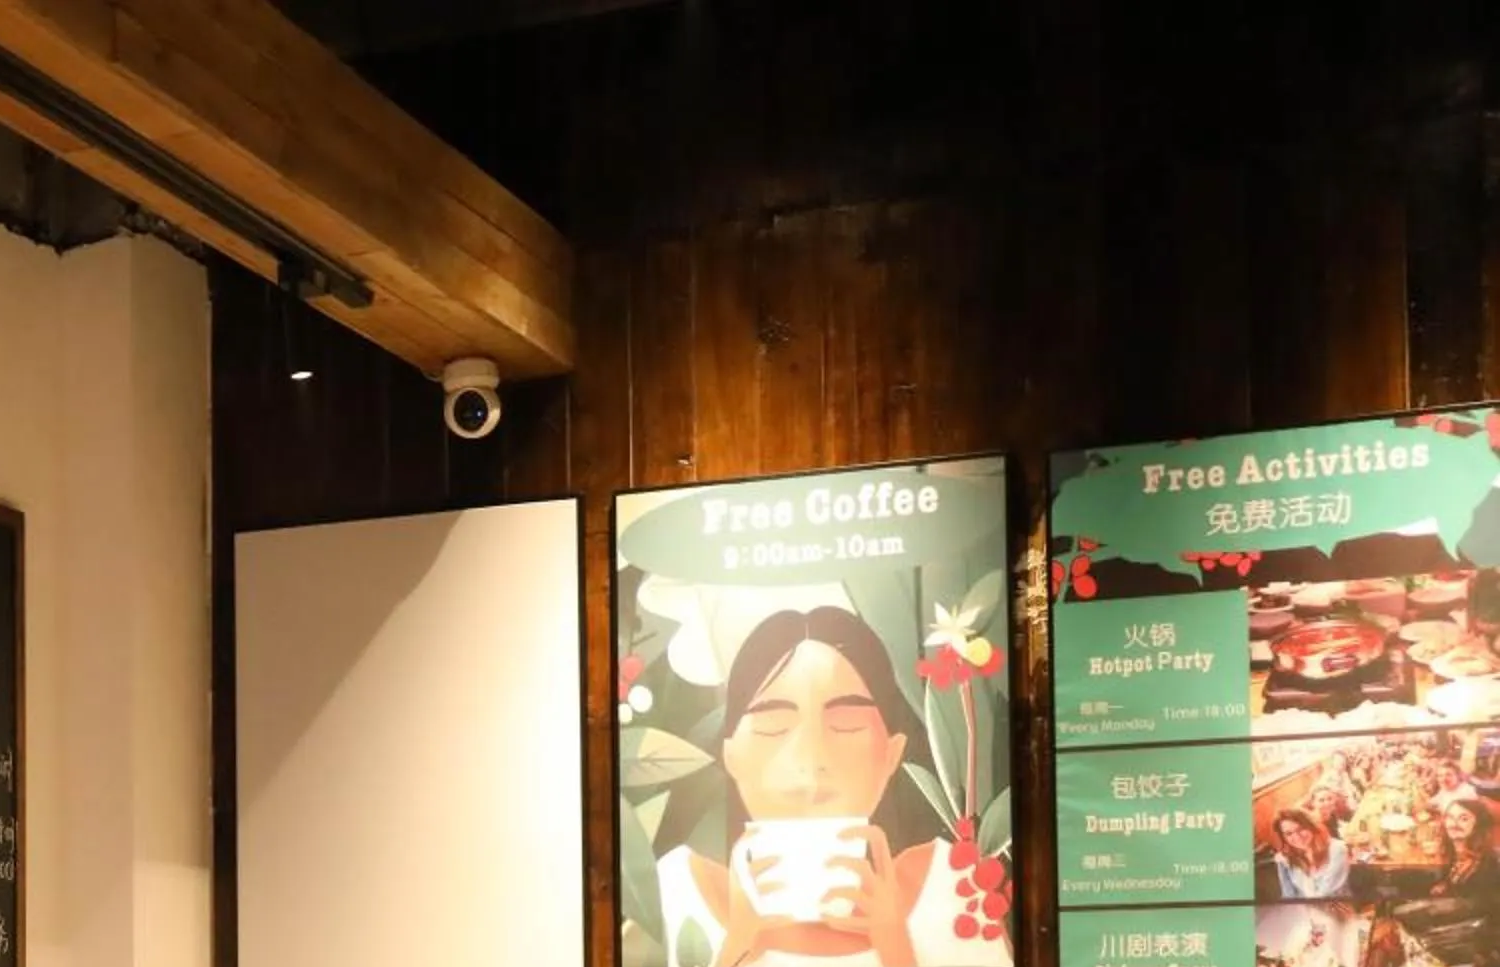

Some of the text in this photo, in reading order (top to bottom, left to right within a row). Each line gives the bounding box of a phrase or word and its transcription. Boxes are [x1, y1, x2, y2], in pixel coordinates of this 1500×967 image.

[1142, 442, 1431, 494] Free Activities
[701, 481, 939, 534] Free Coffee
[1205, 491, 1353, 536] 免费活动
[1124, 623, 1176, 649] 火锅
[1088, 650, 1215, 678] Hotpot Party
[1111, 773, 1191, 800] 包饺子
[1085, 810, 1226, 837] Dumpling Party
[1100, 931, 1209, 959] 川剧表演
